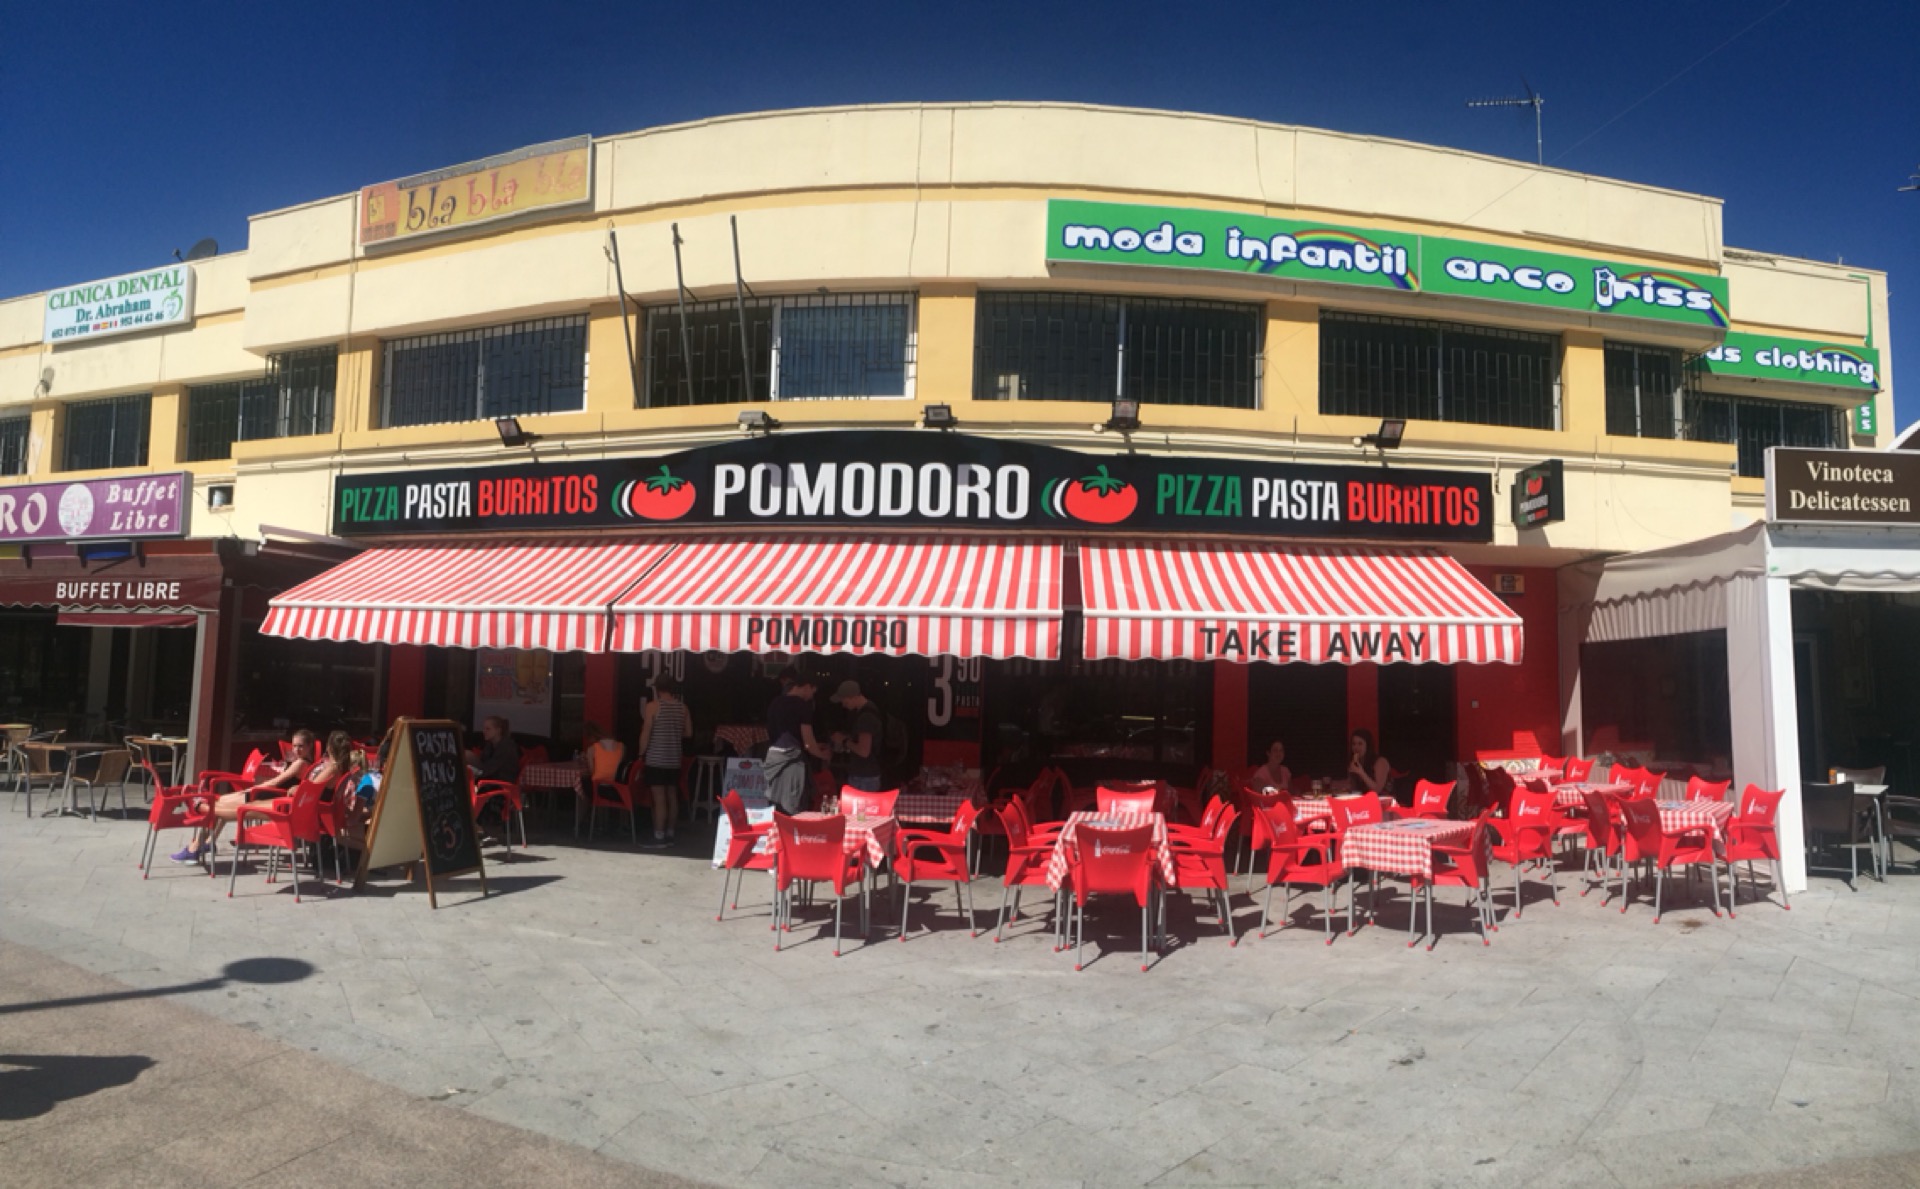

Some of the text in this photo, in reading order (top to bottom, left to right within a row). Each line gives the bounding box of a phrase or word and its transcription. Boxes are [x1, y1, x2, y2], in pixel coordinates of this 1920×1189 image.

[405, 185, 456, 231] bla
[466, 171, 519, 216] bla
[1063, 222, 1205, 256] moda
[1226, 226, 1409, 276] infantil
[1444, 257, 1576, 294] arco
[49, 269, 184, 310] CLINICA DENTAL
[75, 298, 151, 323] Dr. Abraham
[1755, 347, 1874, 384] clothing
[1806, 461, 1894, 484] Vinoteca
[105, 480, 177, 506] Buffet
[340, 474, 599, 522] PIZZA PASTA BURRITOS
[713, 461, 1031, 520] POMODORO
[1157, 473, 1480, 526] PIZZA PASTA BURRITOS
[1789, 489, 1911, 513] Delicatessen
[110, 510, 170, 531] Libre
[55, 582, 181, 600] BUFFET LIBRE
[747, 617, 907, 648] POMODORO
[1200, 628, 1425, 657] TAKE AWAY
[928, 654, 952, 727] 3
[415, 731, 457, 757] PASTA
